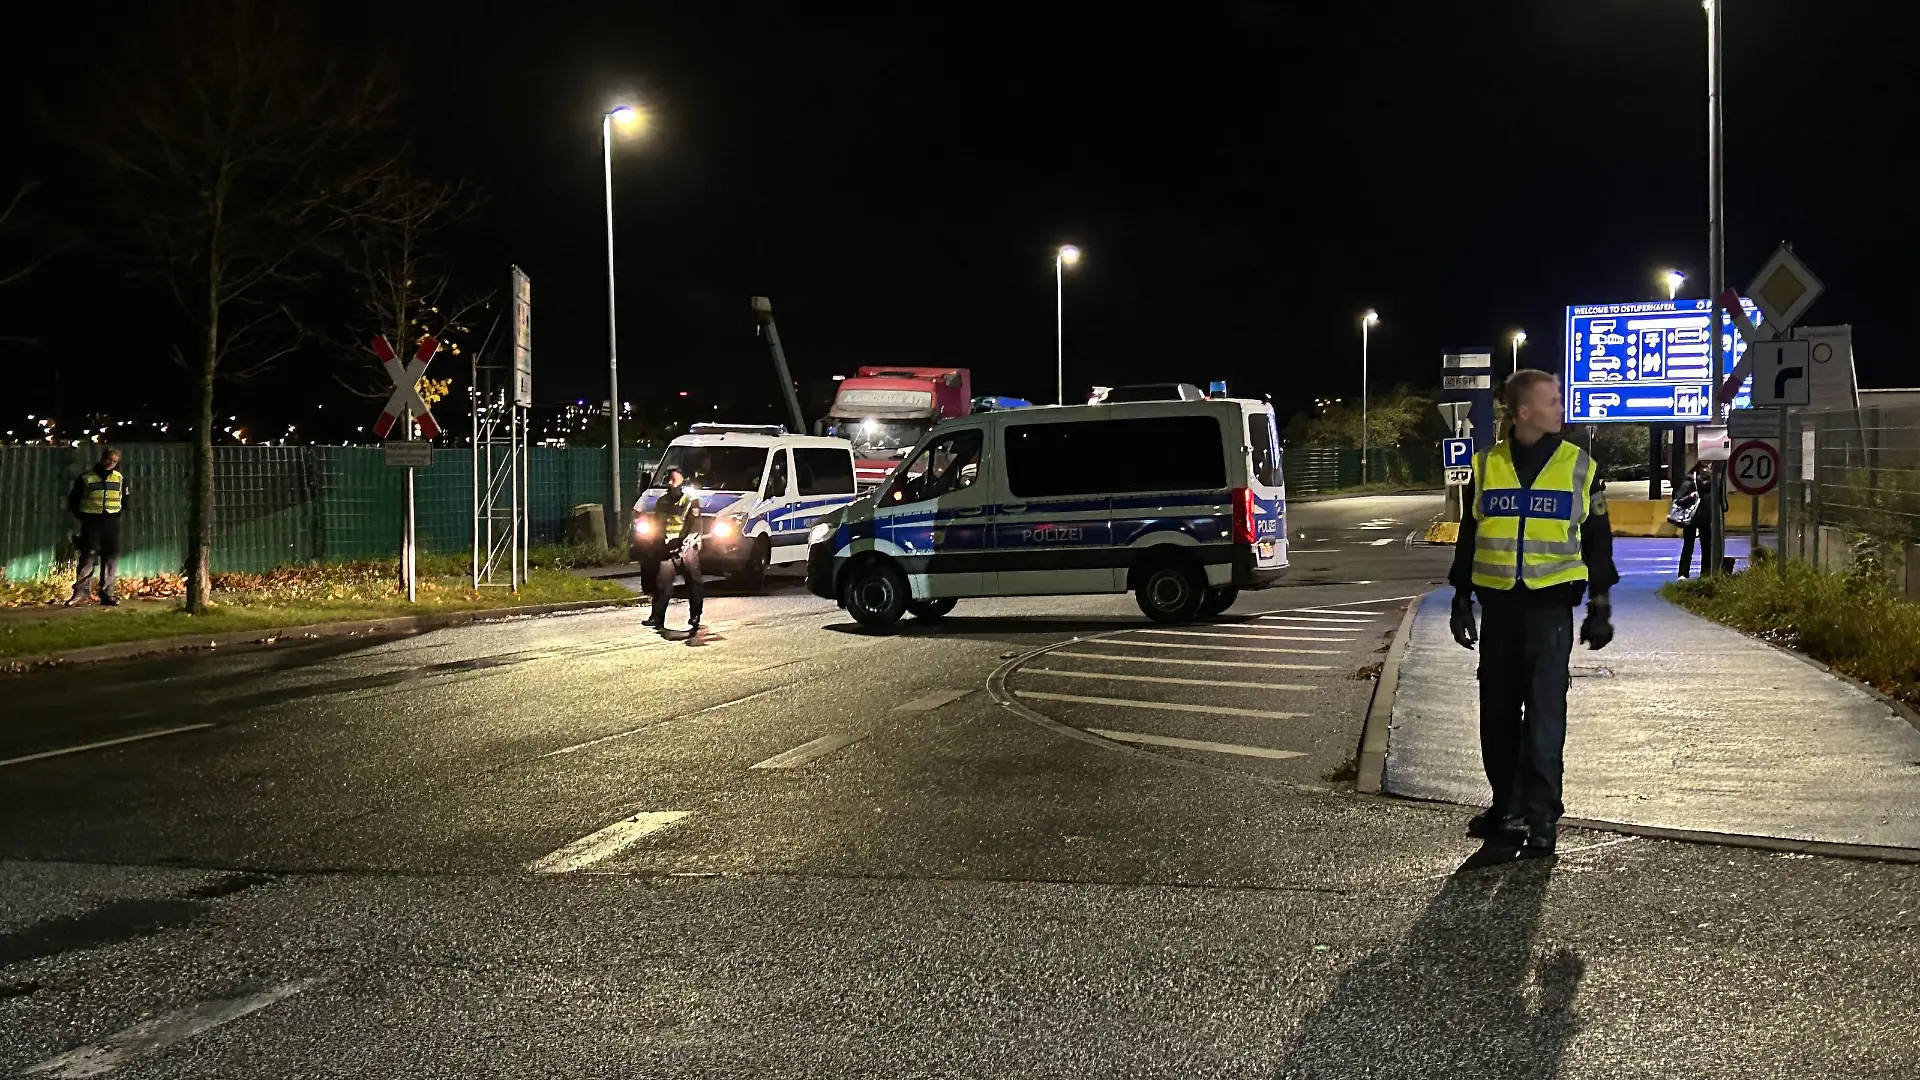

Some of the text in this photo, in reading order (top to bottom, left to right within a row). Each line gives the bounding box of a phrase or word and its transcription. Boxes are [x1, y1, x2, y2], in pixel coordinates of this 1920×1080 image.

[1574, 305, 1608, 315] WELCOME
[1609, 305, 1620, 314] TO
[1450, 442, 1467, 464] P
[1739, 454, 1771, 480] 20
[1022, 528, 1083, 543] POLIZEI
